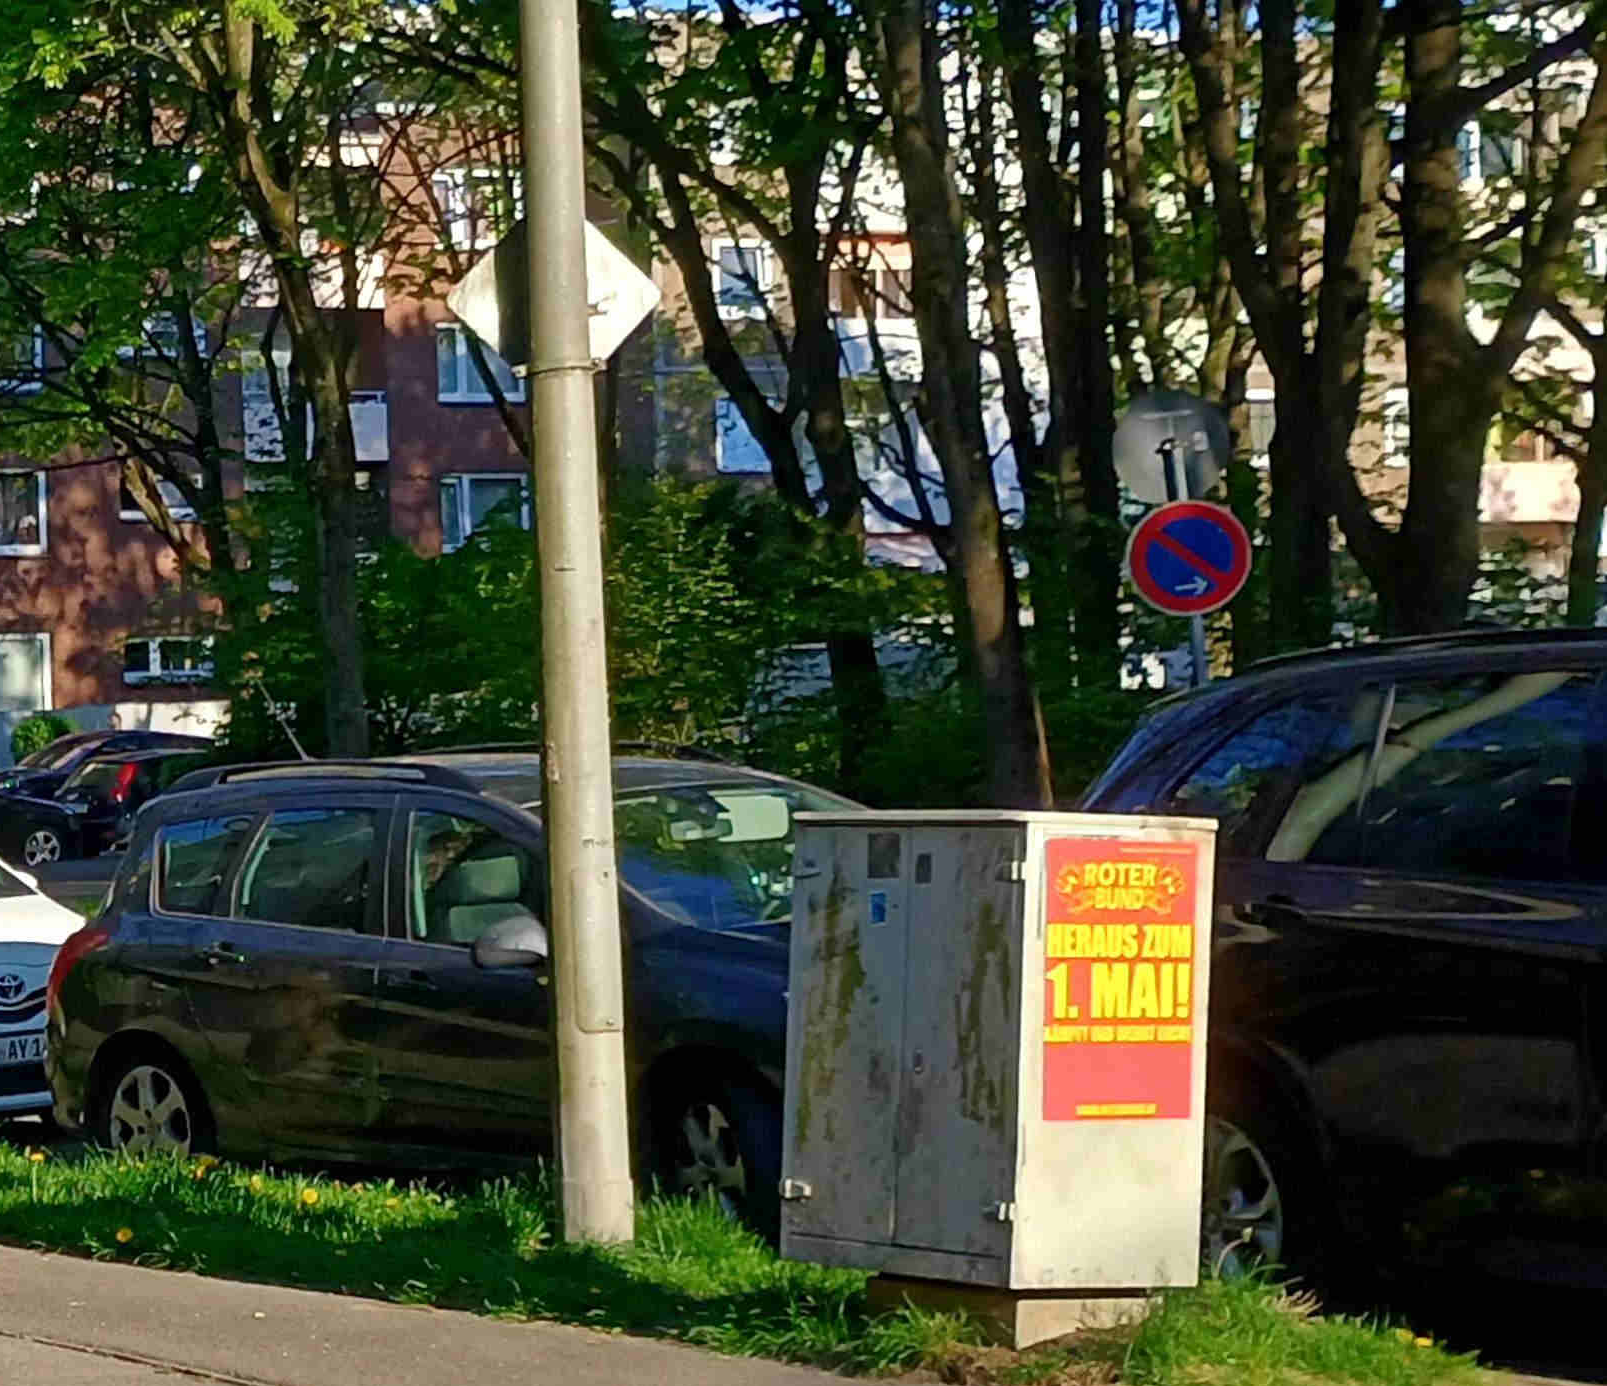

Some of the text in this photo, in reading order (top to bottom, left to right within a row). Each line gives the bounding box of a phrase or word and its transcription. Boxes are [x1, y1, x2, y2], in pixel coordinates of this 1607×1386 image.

[1084, 863, 1157, 886] ROTER
[1094, 889, 1145, 910] BUND
[1046, 924, 1192, 958] HERAUS ZUM
[1046, 962, 1191, 1018] 1. MAI!
